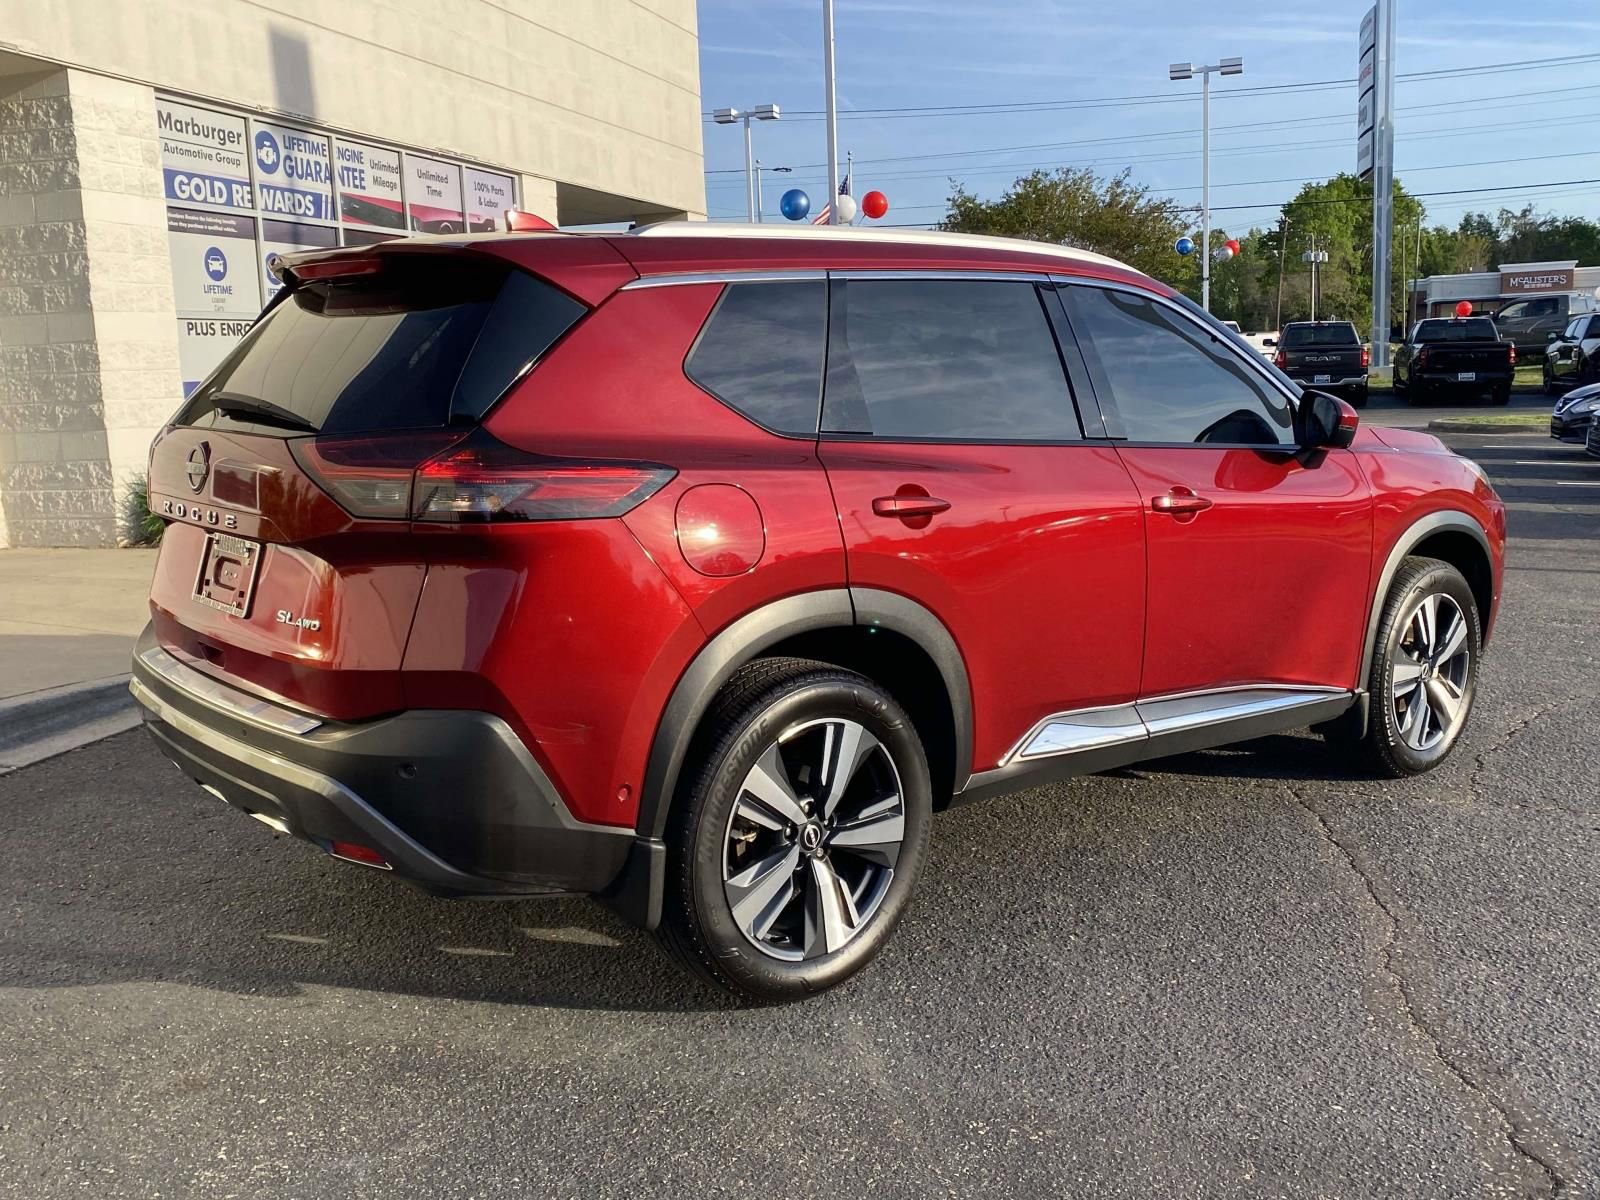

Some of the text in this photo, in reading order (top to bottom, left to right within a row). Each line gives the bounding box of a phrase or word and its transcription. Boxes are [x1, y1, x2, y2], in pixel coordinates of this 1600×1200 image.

[157, 109, 242, 146] Marburger
[163, 142, 241, 168] Automotive Group
[282, 134, 365, 165] LIFETIME NGINE
[369, 159, 399, 174] Unlimited
[372, 175, 398, 191] Mileage
[416, 168, 449, 184] Unlimited
[173, 174, 228, 204] GOLD
[426, 185, 443, 197] Time
[473, 181, 505, 196] 100% Parts
[484, 198, 499, 208] Labor
[203, 284, 233, 295] LIFETIME
[186, 321, 216, 336] PLUS
[163, 500, 237, 529] ROGUE
[276, 609, 321, 631] SL AWD
